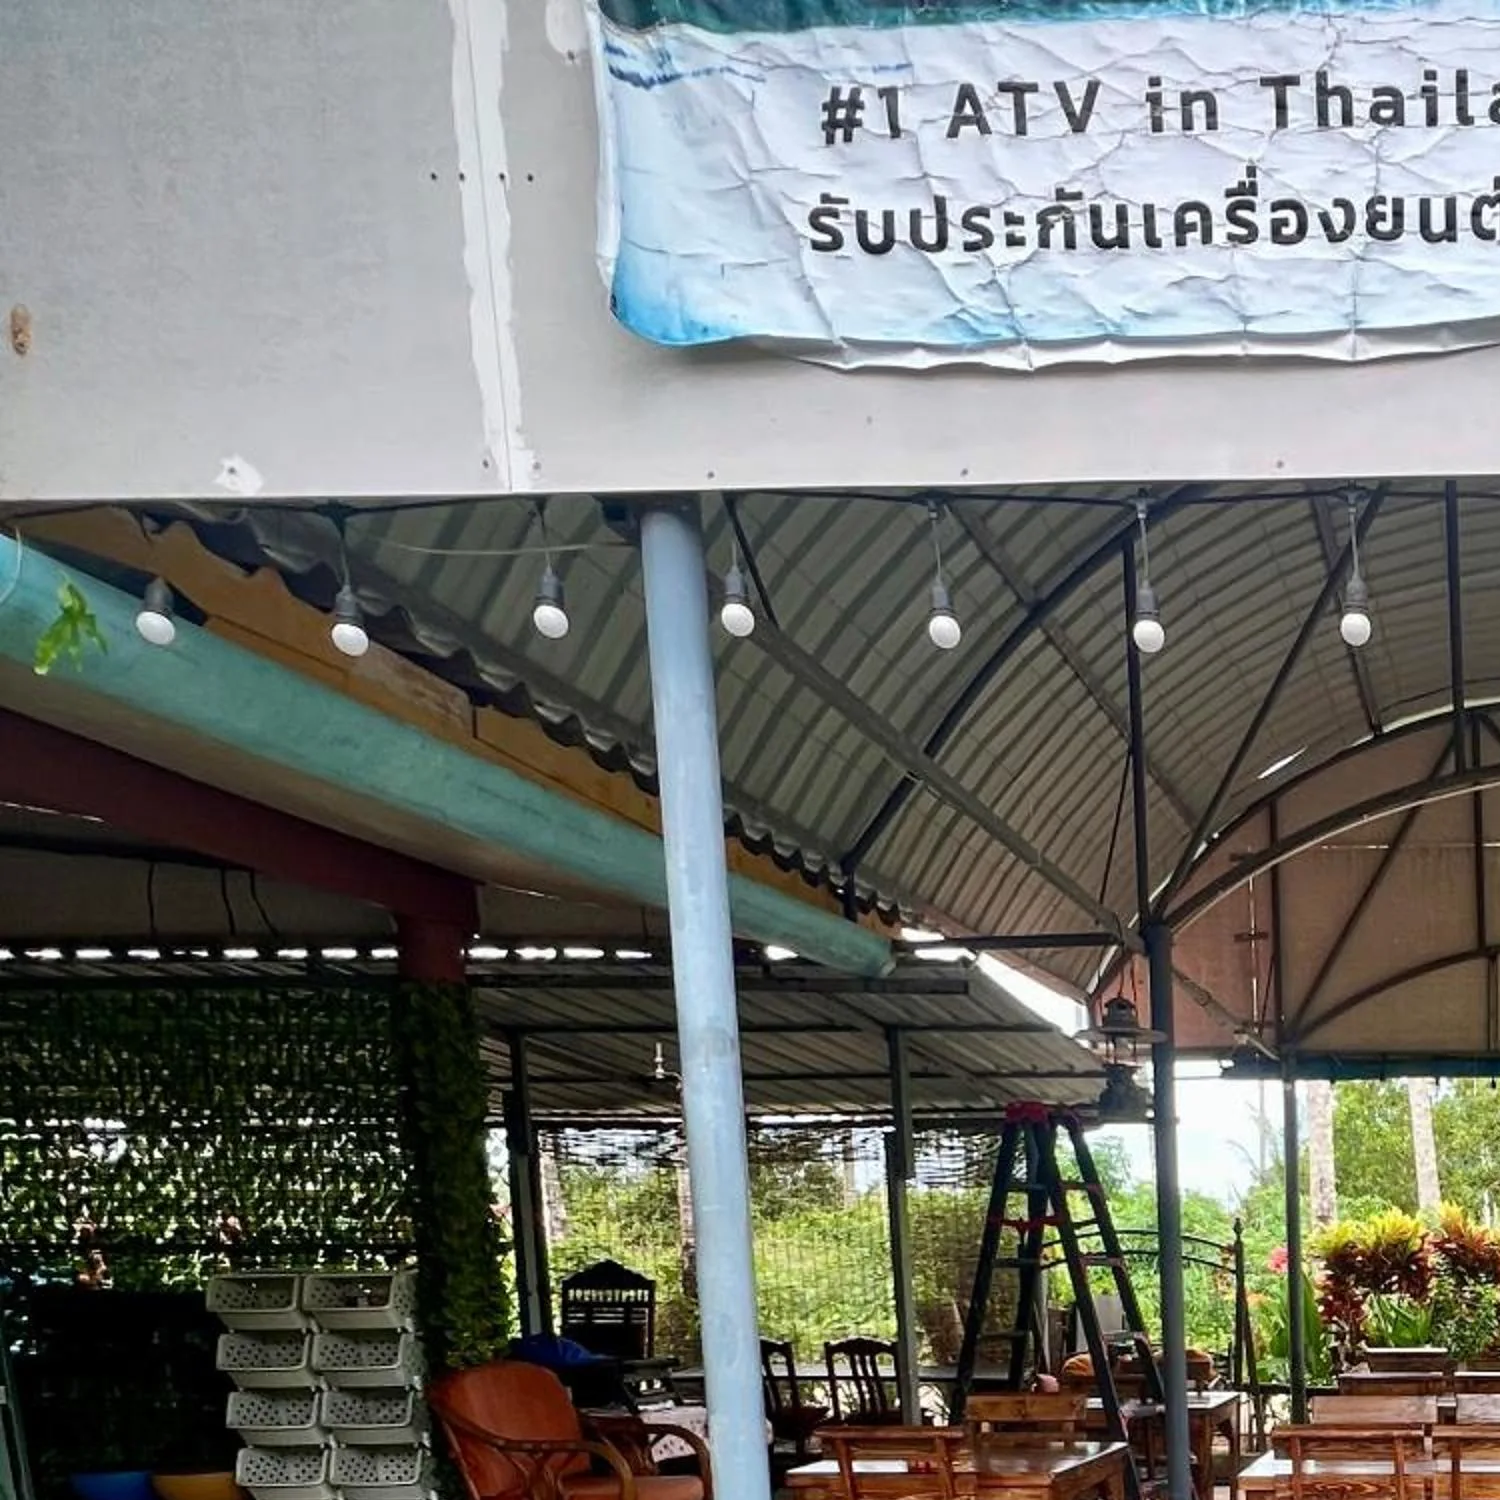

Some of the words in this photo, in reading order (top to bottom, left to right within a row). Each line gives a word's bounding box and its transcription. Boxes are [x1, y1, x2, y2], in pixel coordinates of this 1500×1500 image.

[822, 84, 901, 145] #1
[946, 80, 1100, 138] ATV
[1145, 76, 1219, 133] in
